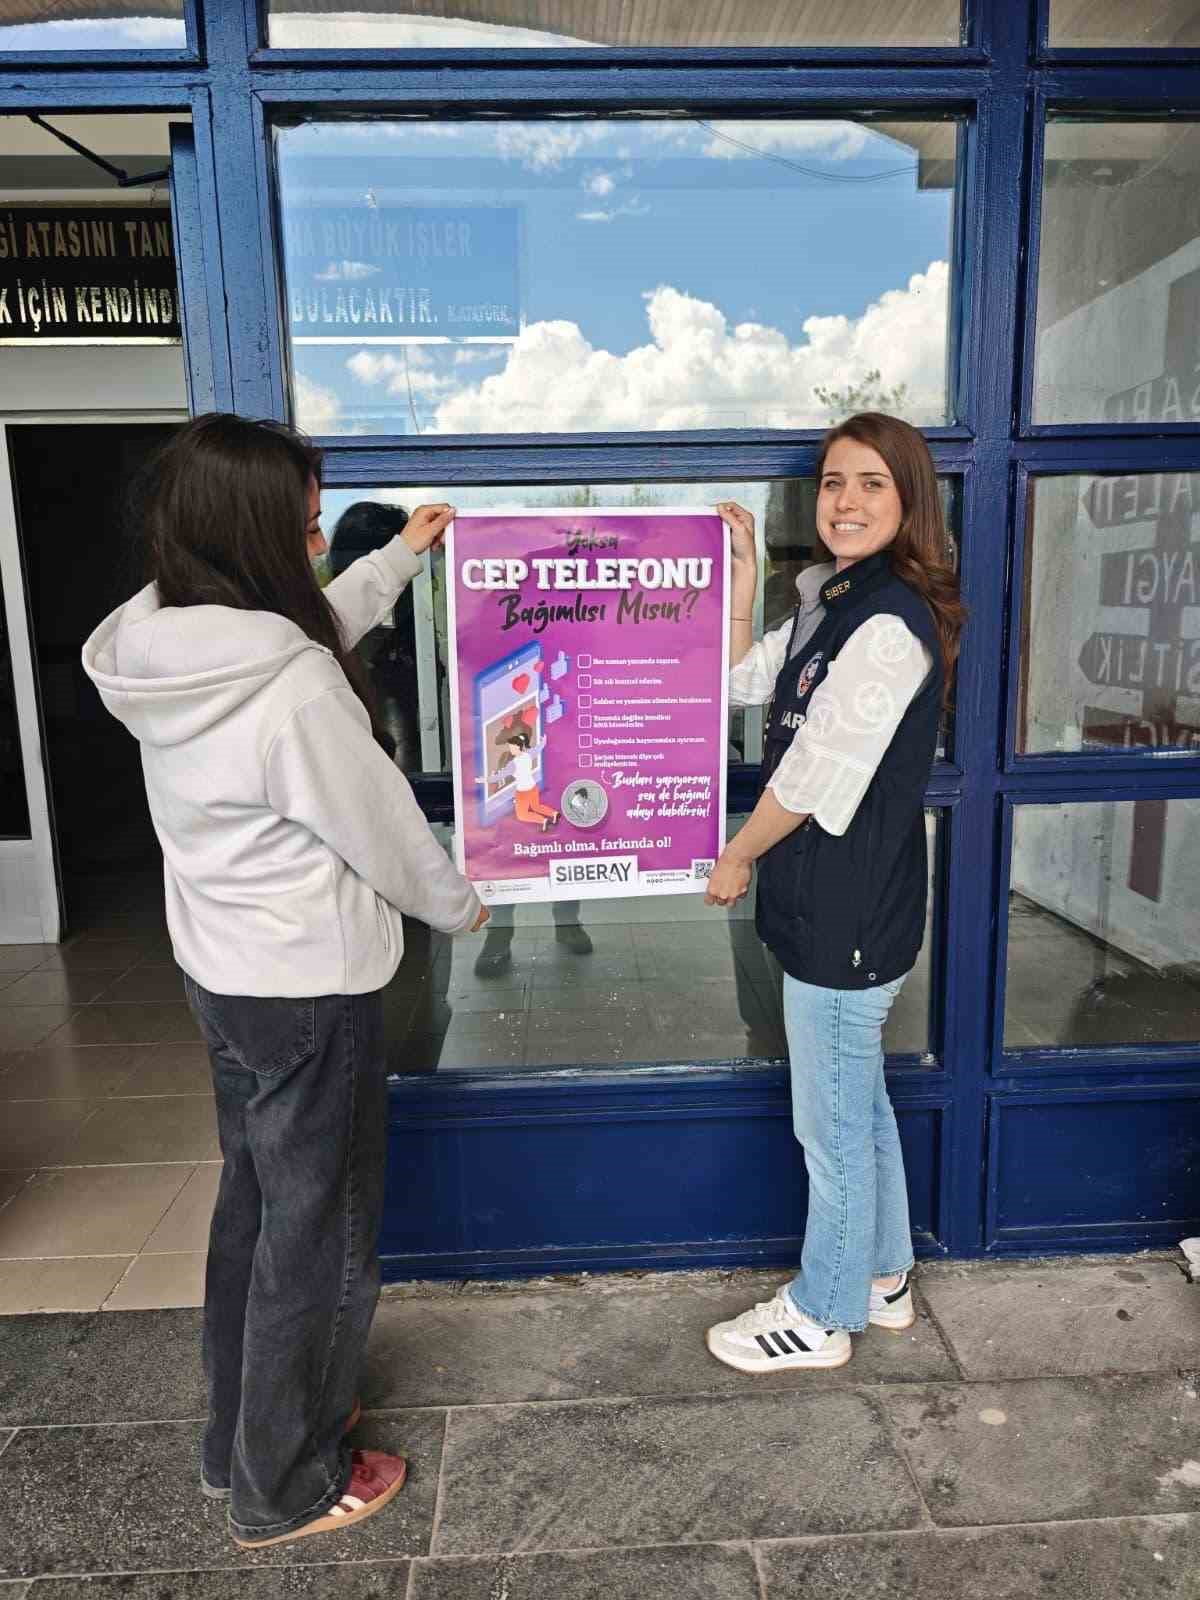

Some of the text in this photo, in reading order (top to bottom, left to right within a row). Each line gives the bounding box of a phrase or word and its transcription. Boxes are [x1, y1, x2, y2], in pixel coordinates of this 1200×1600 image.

[26, 220, 116, 257] ATASINI
[326, 216, 400, 257] BÜYÜK
[16, 278, 68, 332] İÇİN
[461, 557, 713, 590] CEP TELEFONU
[498, 588, 700, 633] Bağımlısı Mısın?
[611, 770, 711, 789] Bunları yapıyorsan
[637, 786, 711, 805] sen de bağımlı
[625, 804, 655, 820] adayı
[512, 837, 673, 858] Bağımlı olma, farkında ol!
